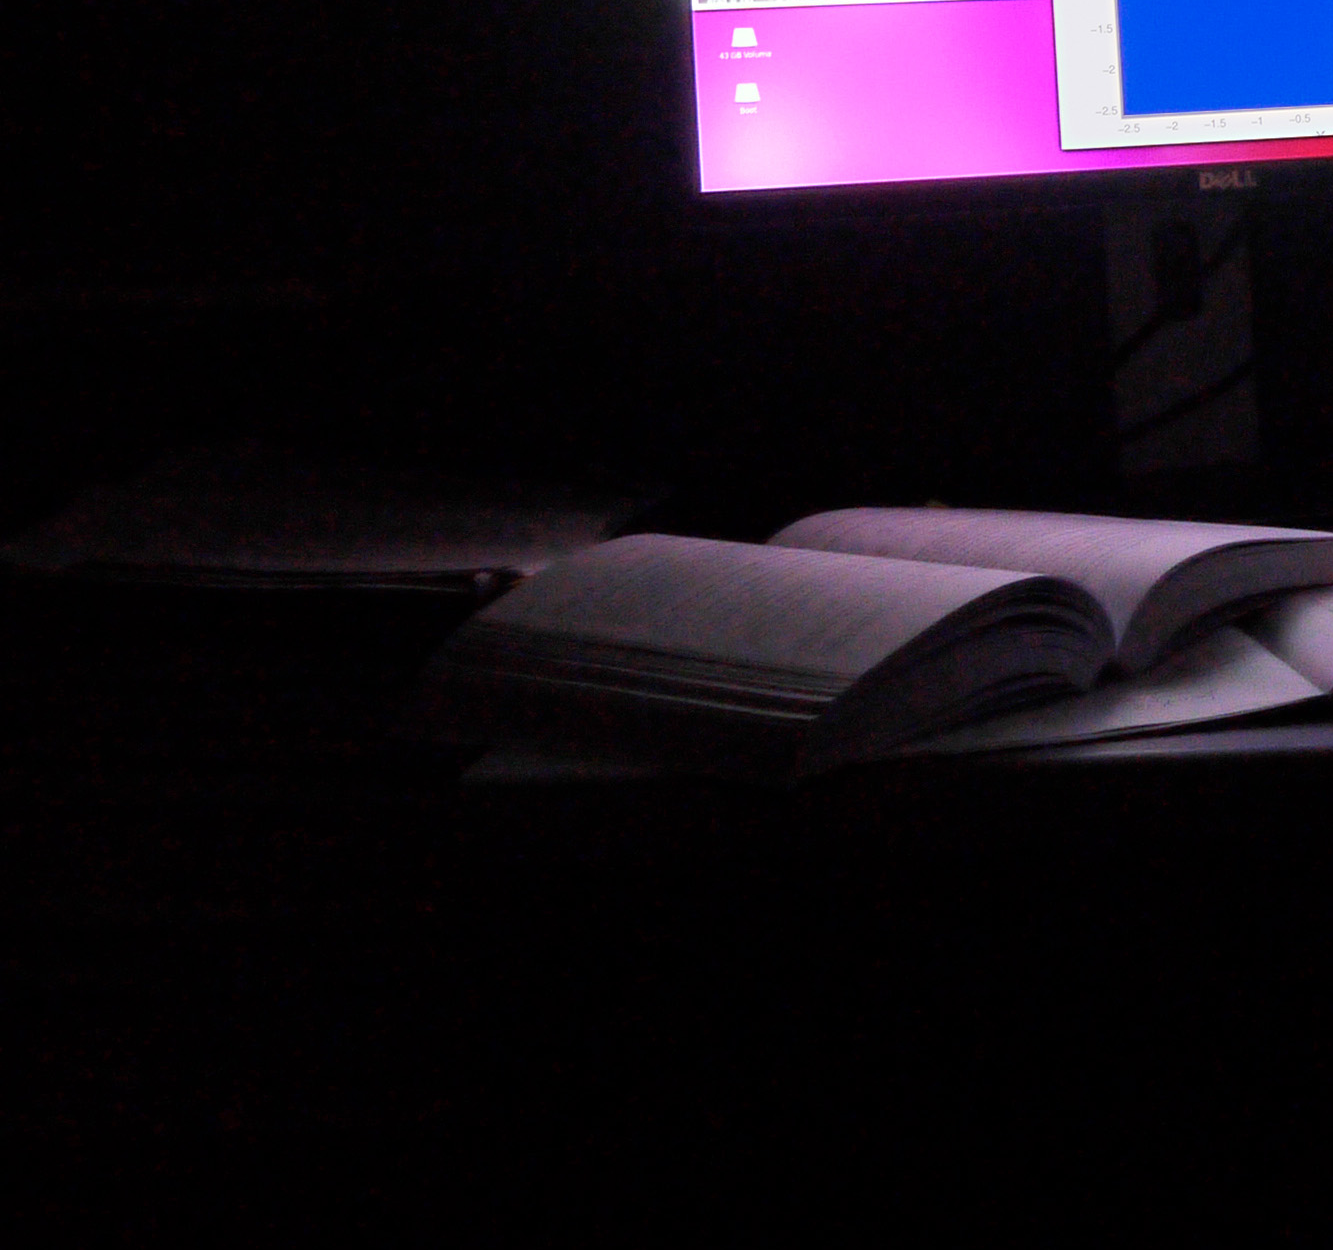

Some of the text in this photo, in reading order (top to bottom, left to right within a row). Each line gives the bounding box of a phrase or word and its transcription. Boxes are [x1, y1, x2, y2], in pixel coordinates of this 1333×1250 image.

[1090, 24, 1114, 34] -1.5
[1102, 65, 1116, 75] -2
[1095, 106, 1118, 116] -2.5
[1117, 123, 1141, 134] -2.5
[1165, 121, 1179, 131] -2
[1204, 118, 1227, 129] -1.5
[1288, 114, 1312, 124] -0.5
